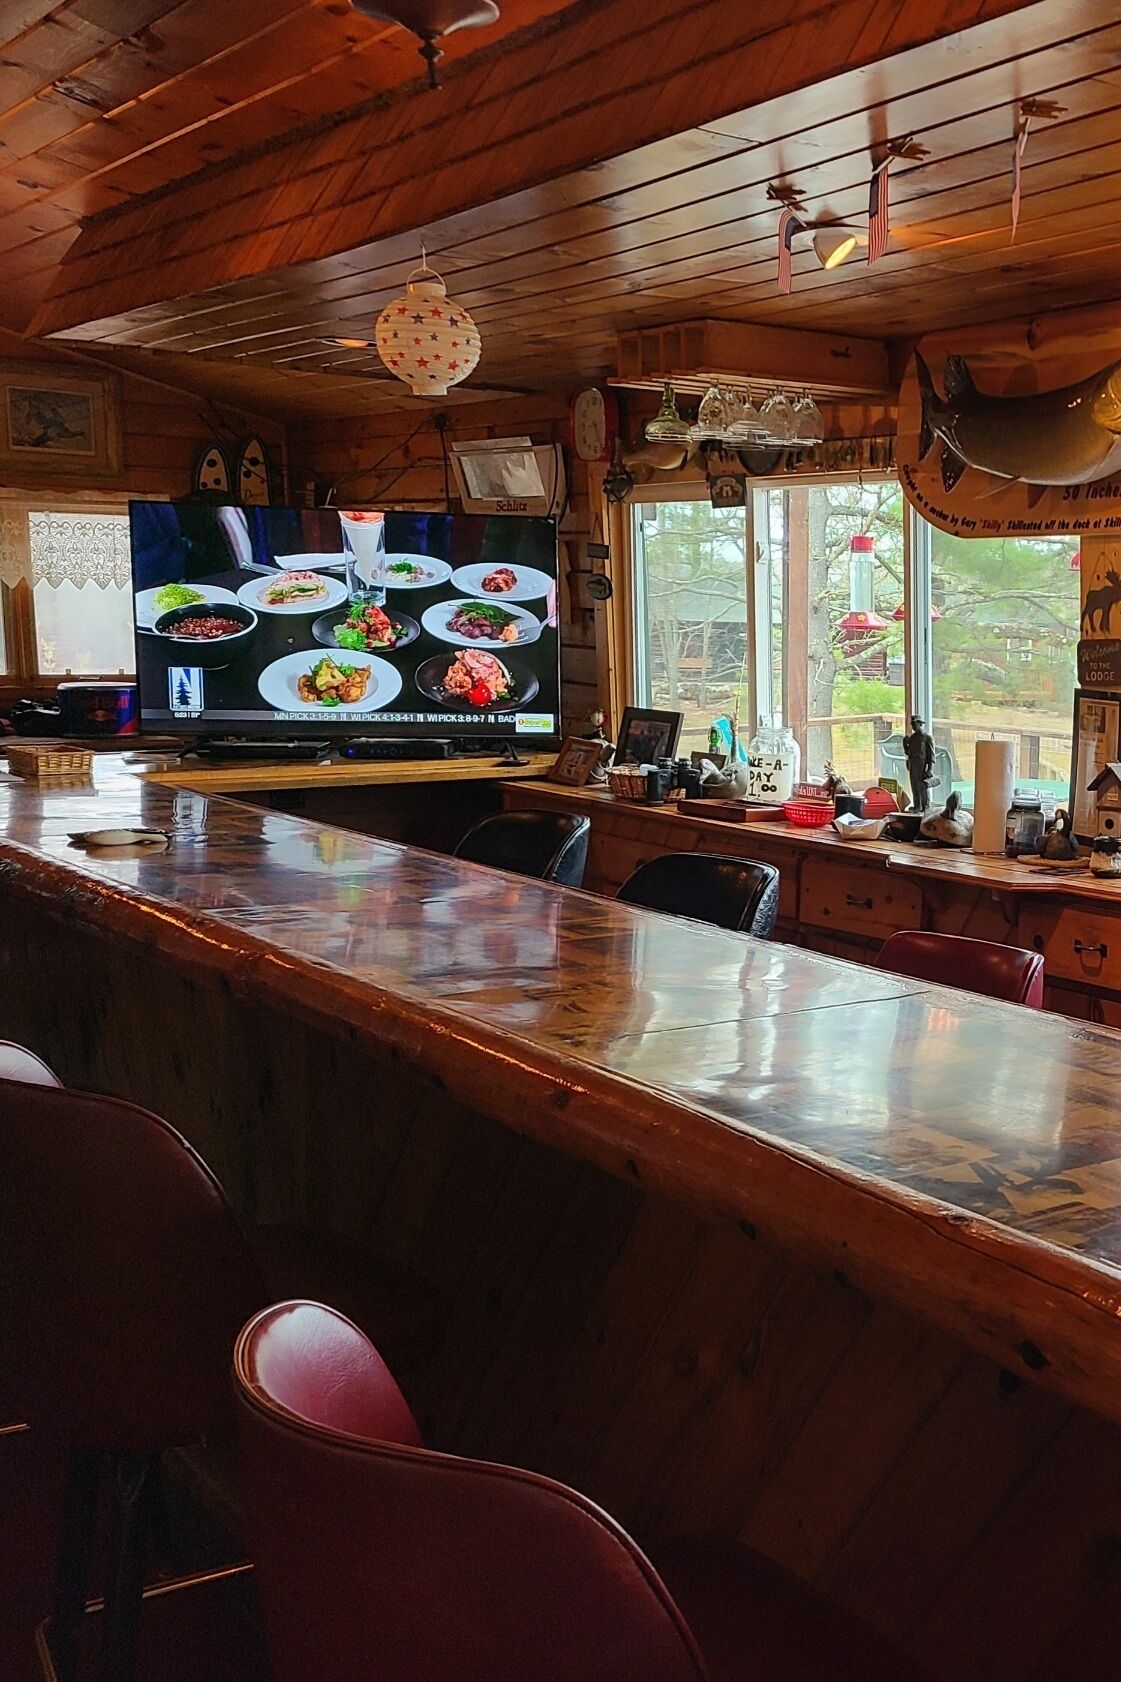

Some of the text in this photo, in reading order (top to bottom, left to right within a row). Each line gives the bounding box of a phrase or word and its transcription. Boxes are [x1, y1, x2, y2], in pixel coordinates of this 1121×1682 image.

[902, 464, 918, 492] Caught
[950, 514, 959, 527] by
[961, 516, 977, 531] Gary
[1044, 519, 1056, 530] off
[1058, 518, 1070, 530] the
[1073, 517, 1090, 529] dock
[1093, 519, 1102, 529] at
[1062, 485, 1082, 501] 50
[496, 500, 528, 512] Schlitz
[1090, 662, 1110, 670] TO THE
[1085, 671, 1115, 681] LODGE
[274, 712, 288, 720] MN
[290, 712, 309, 720] PICK
[351, 713, 362, 721] WI
[362, 713, 382, 721] PICK
[427, 714, 438, 722] WI
[438, 714, 457, 722] PICK
[749, 770, 774, 783] DAY
[880, 782, 896, 792] FREE
